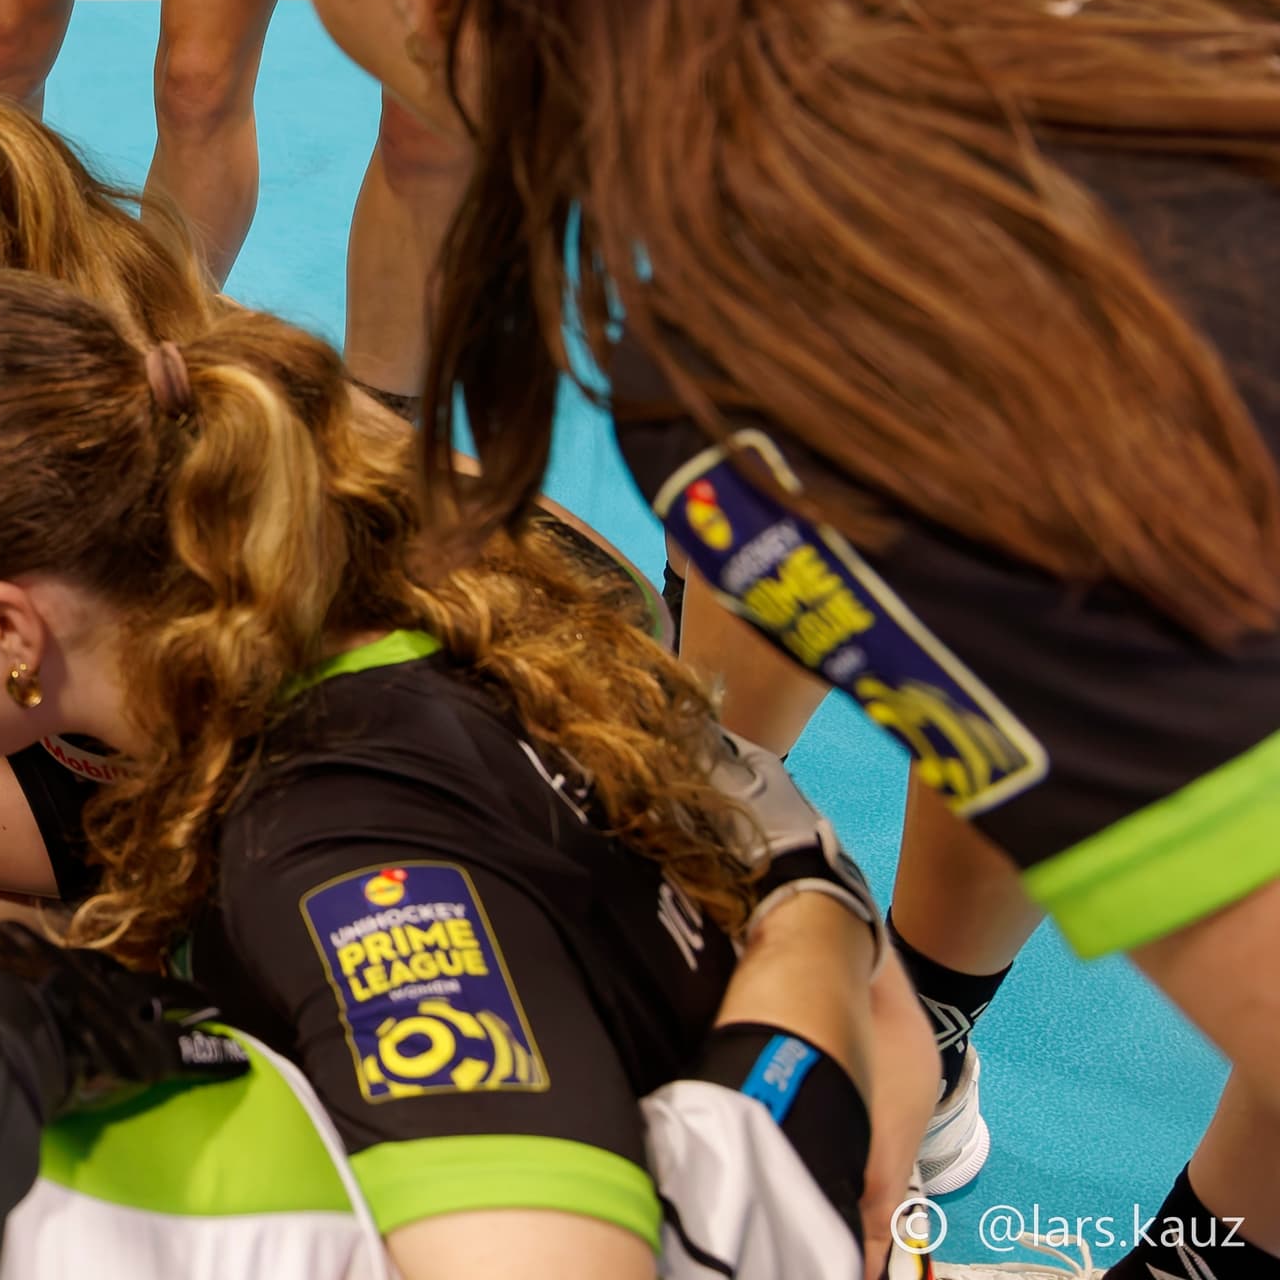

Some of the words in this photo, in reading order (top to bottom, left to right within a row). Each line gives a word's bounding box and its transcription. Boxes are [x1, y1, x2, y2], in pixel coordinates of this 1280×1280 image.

[330, 903, 466, 947] UNIHOCKEY
[336, 918, 482, 976] PRIME
[348, 948, 490, 1002] LEAGUE
